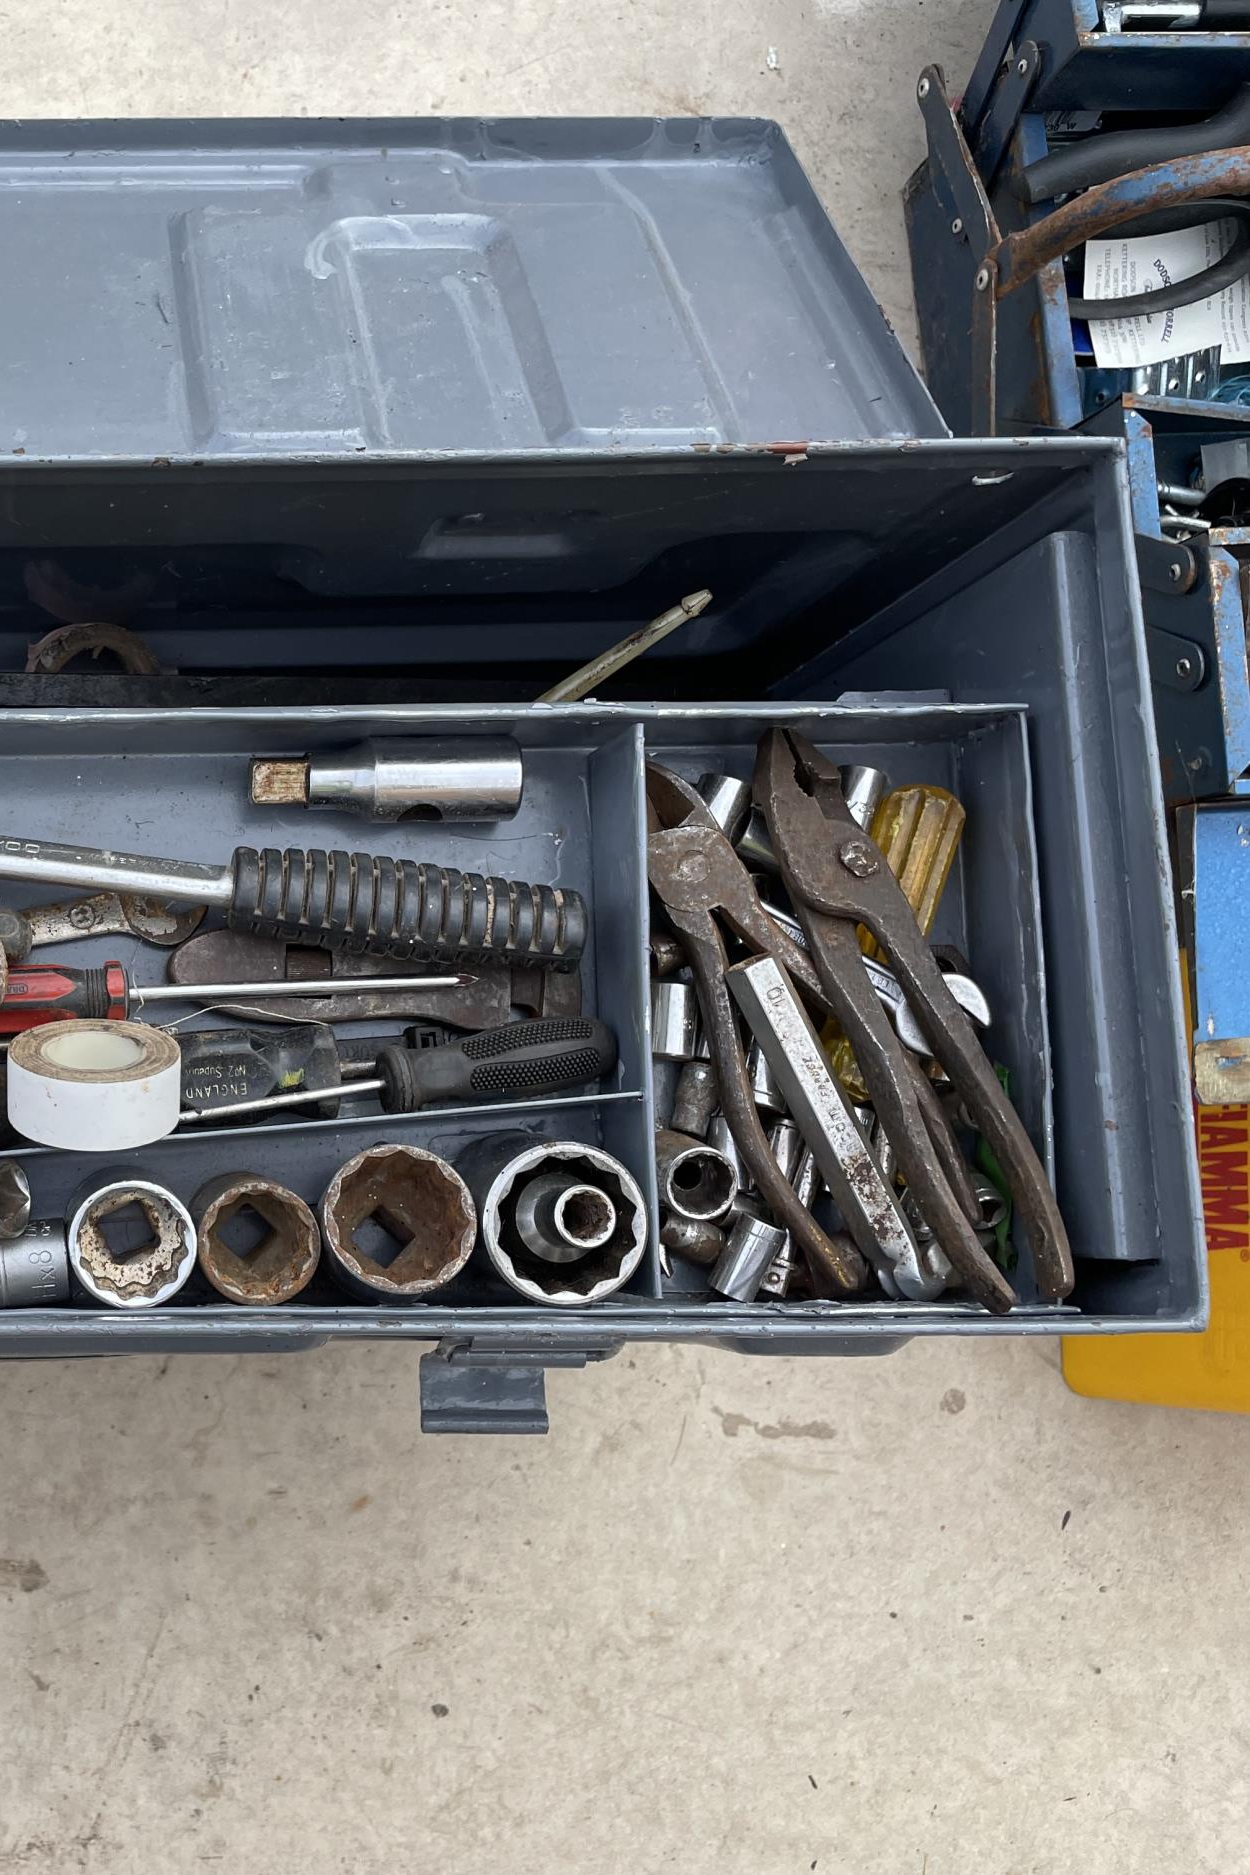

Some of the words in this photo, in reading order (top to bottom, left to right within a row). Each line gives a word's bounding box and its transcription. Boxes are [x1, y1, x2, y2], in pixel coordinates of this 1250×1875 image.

[1153, 258, 1172, 288] DODSO
[1161, 310, 1174, 343] ORRELL
[185, 1082, 246, 1098] ENGLAND
[1201, 1104, 1250, 1249] IAMMA
